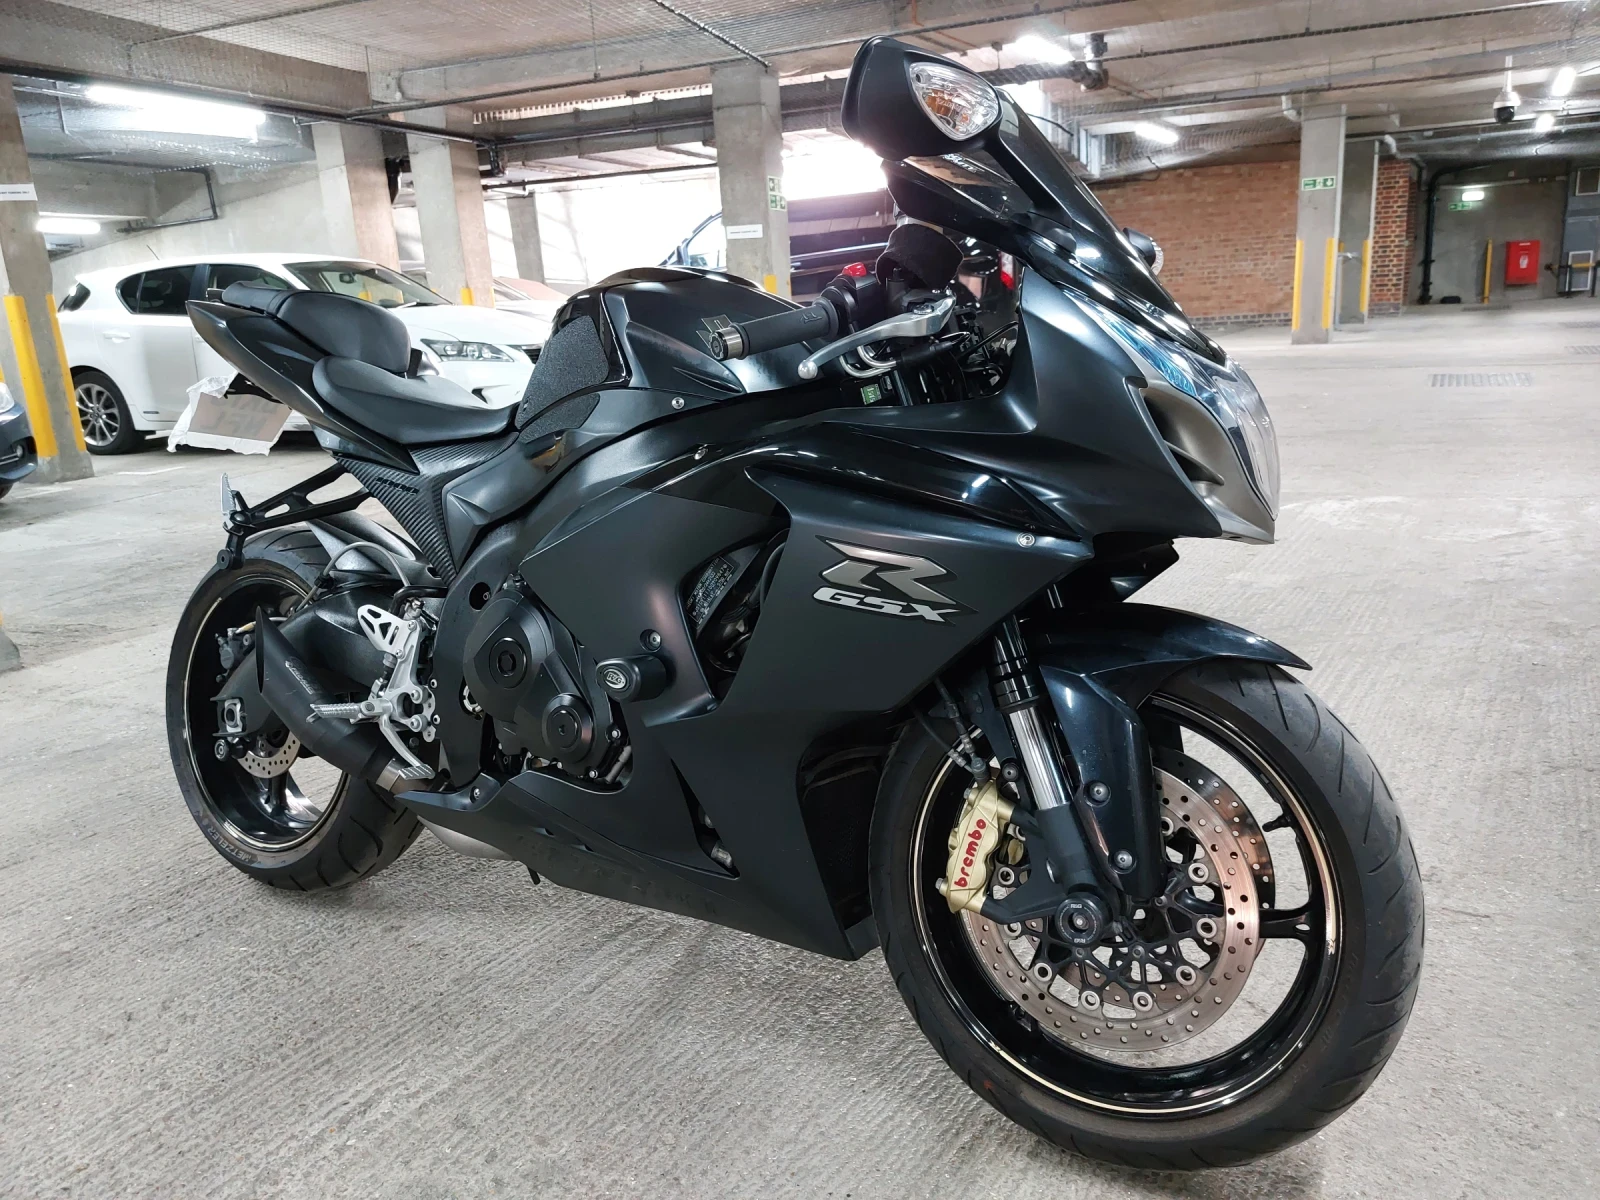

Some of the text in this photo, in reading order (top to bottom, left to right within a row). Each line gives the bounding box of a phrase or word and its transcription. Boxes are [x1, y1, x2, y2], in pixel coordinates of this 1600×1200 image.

[813, 586, 961, 622] GSX
[207, 826, 252, 862] METZELER
[953, 818, 987, 888] brembo
